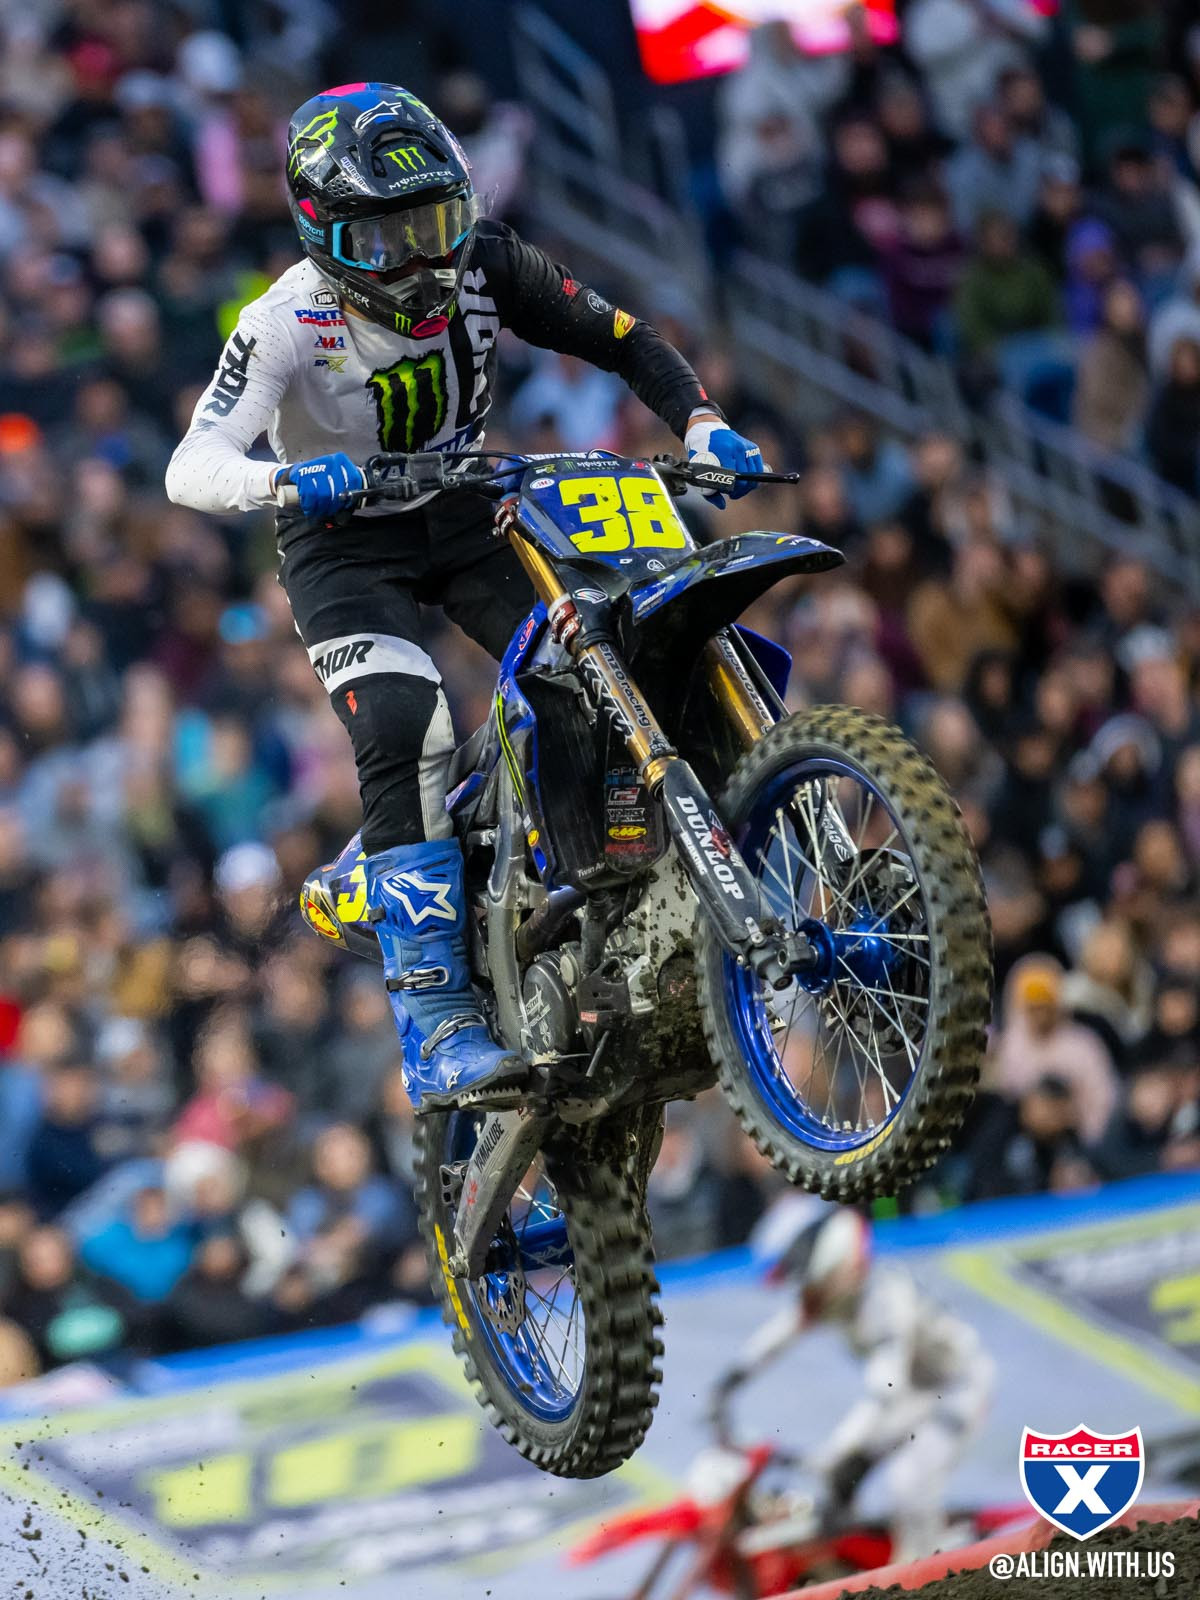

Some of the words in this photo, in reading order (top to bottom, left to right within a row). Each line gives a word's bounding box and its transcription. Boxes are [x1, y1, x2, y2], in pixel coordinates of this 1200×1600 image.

[203, 331, 257, 417] THOR
[298, 464, 326, 477] THOR
[695, 471, 735, 485] ARC
[558, 476, 687, 553] 38
[676, 796, 745, 899] DUNLOP
[473, 1117, 505, 1175] YAMALUBE
